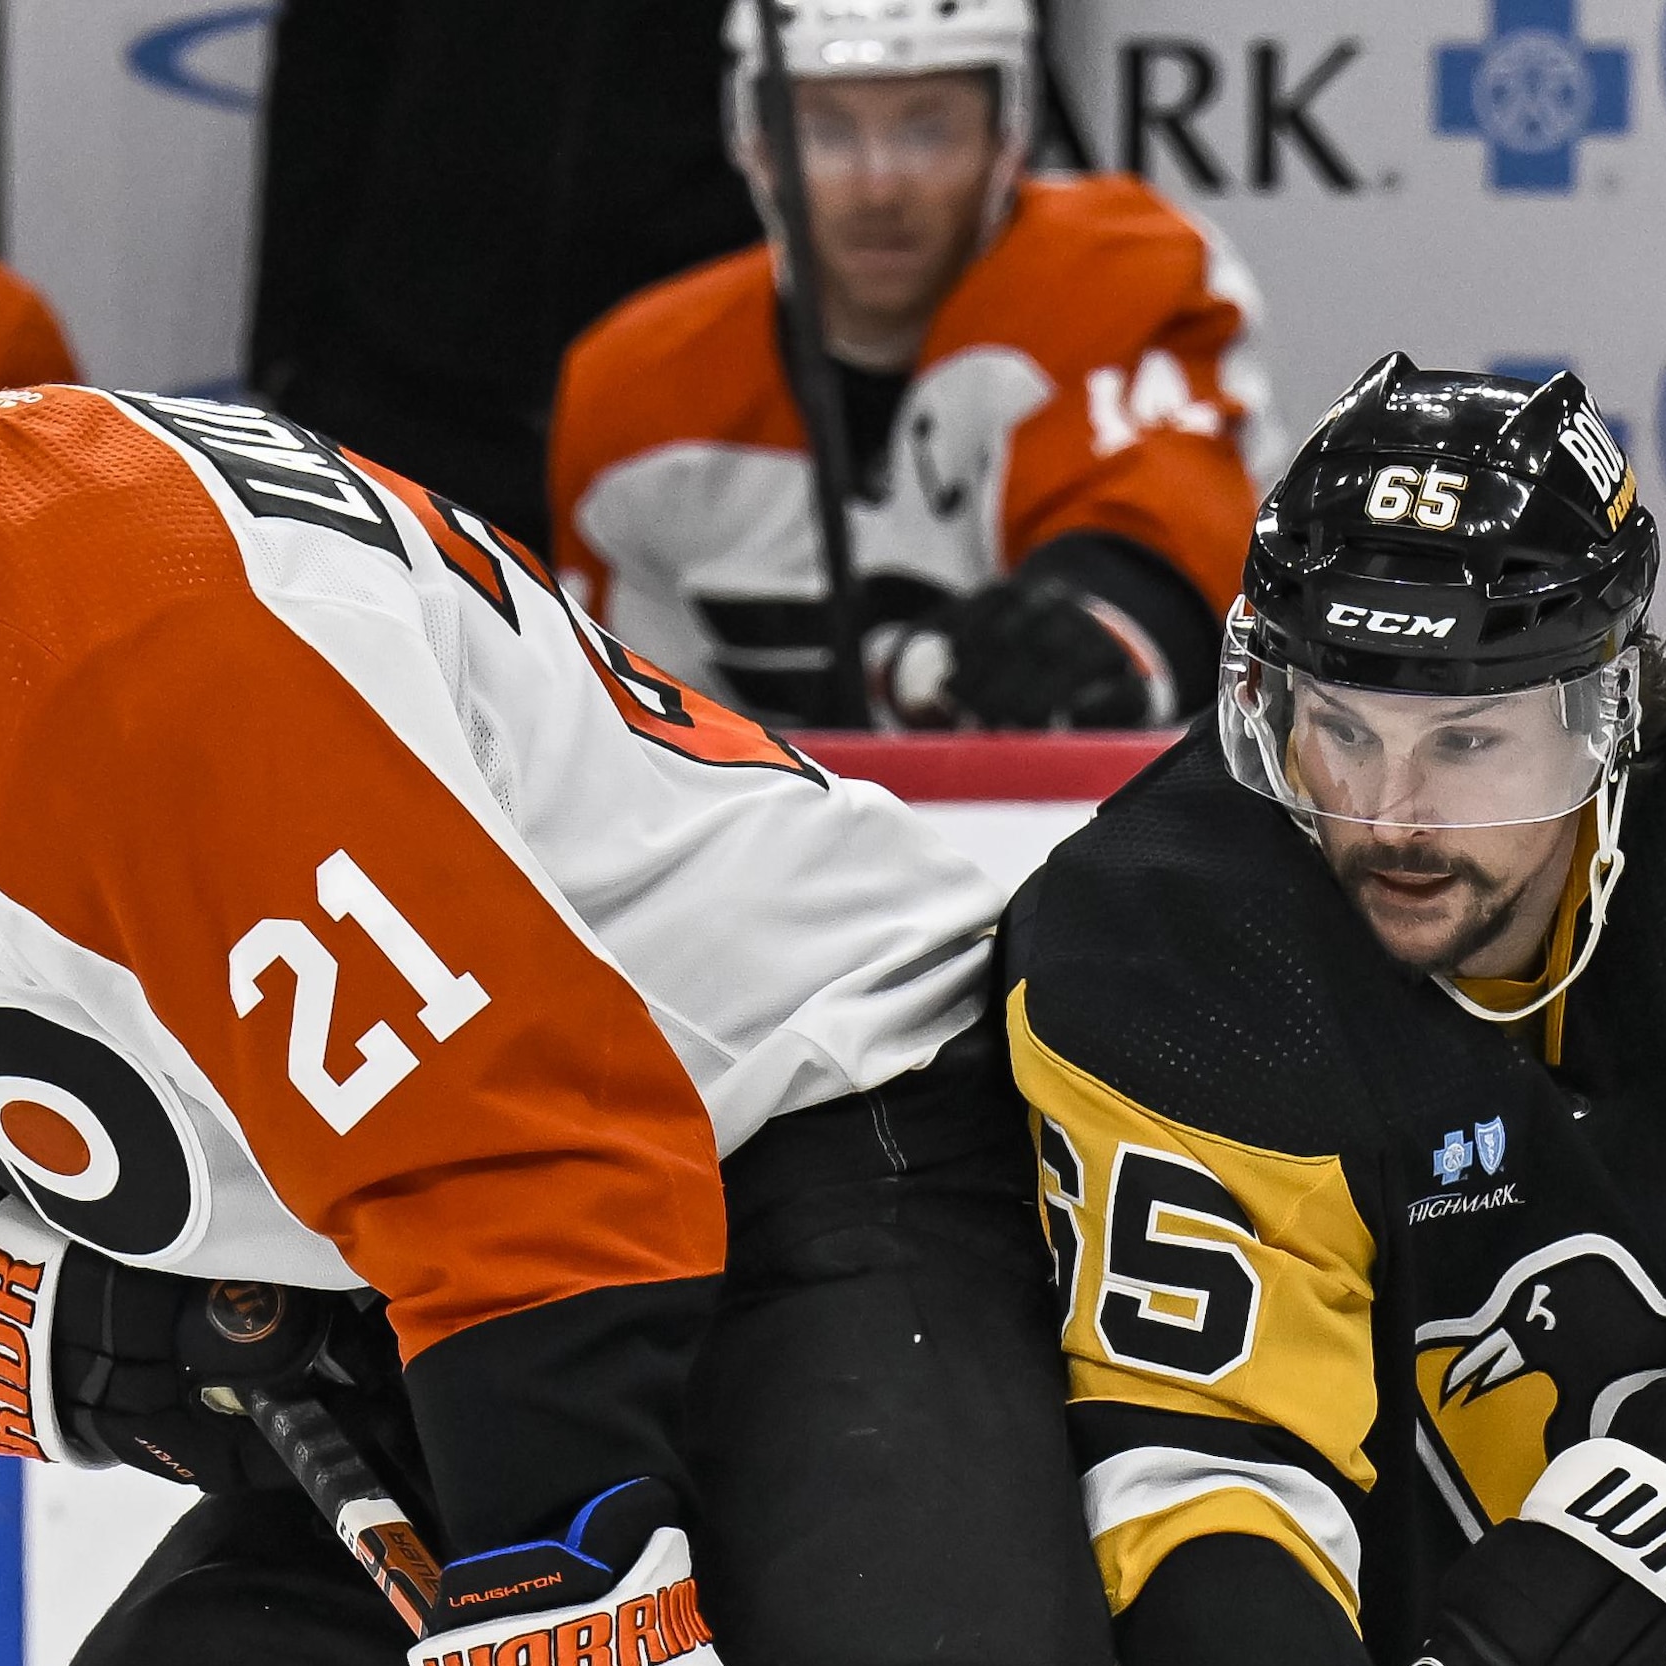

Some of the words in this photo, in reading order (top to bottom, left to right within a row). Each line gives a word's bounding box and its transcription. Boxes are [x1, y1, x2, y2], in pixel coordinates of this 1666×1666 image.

[1364, 465, 1470, 532] 65
[1326, 602, 1457, 639] CCM
[229, 848, 493, 1136] 21
[449, 1571, 563, 1608] LAUGHTON
